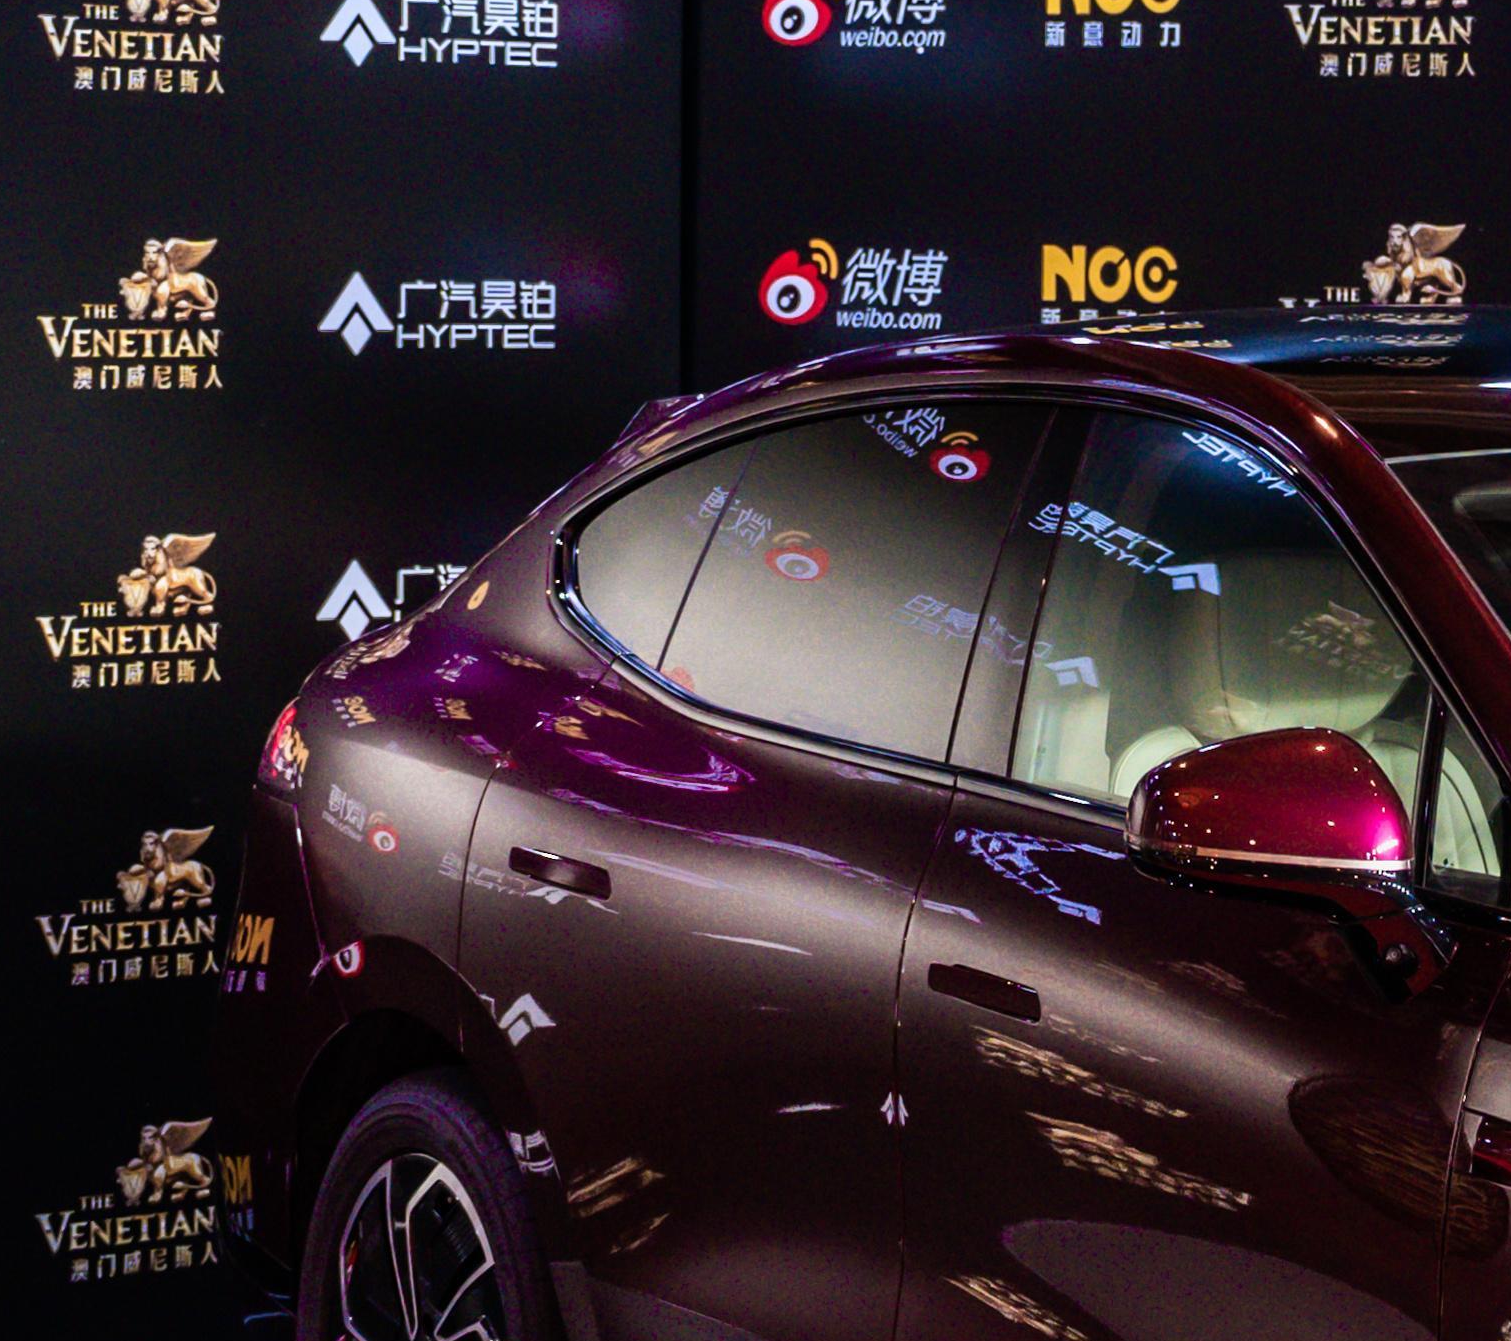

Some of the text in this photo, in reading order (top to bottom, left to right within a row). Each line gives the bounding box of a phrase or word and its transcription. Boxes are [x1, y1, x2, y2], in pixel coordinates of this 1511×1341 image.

[83, 4, 119, 20] THE
[1285, 0, 1473, 45] VENETIAN
[38, 10, 222, 62] VENETIAN
[841, 27, 945, 52] weibo.com
[1045, 22, 1180, 47] 新意动力
[399, 37, 557, 67] HYPTEC
[1320, 52, 1475, 76] 澳门威尼斯人
[75, 66, 224, 93] 澳门威尼斯人
[842, 248, 948, 306] 微博
[1042, 245, 1177, 303] NOC
[398, 280, 556, 319] 广汽昊铂
[37, 311, 220, 357] VENETIAN
[837, 308, 942, 330] weibo.com
[397, 322, 555, 348] HYPTEC
[36, 616, 218, 658] VENETIAN
[72, 658, 221, 688] 澳门威尼斯人
